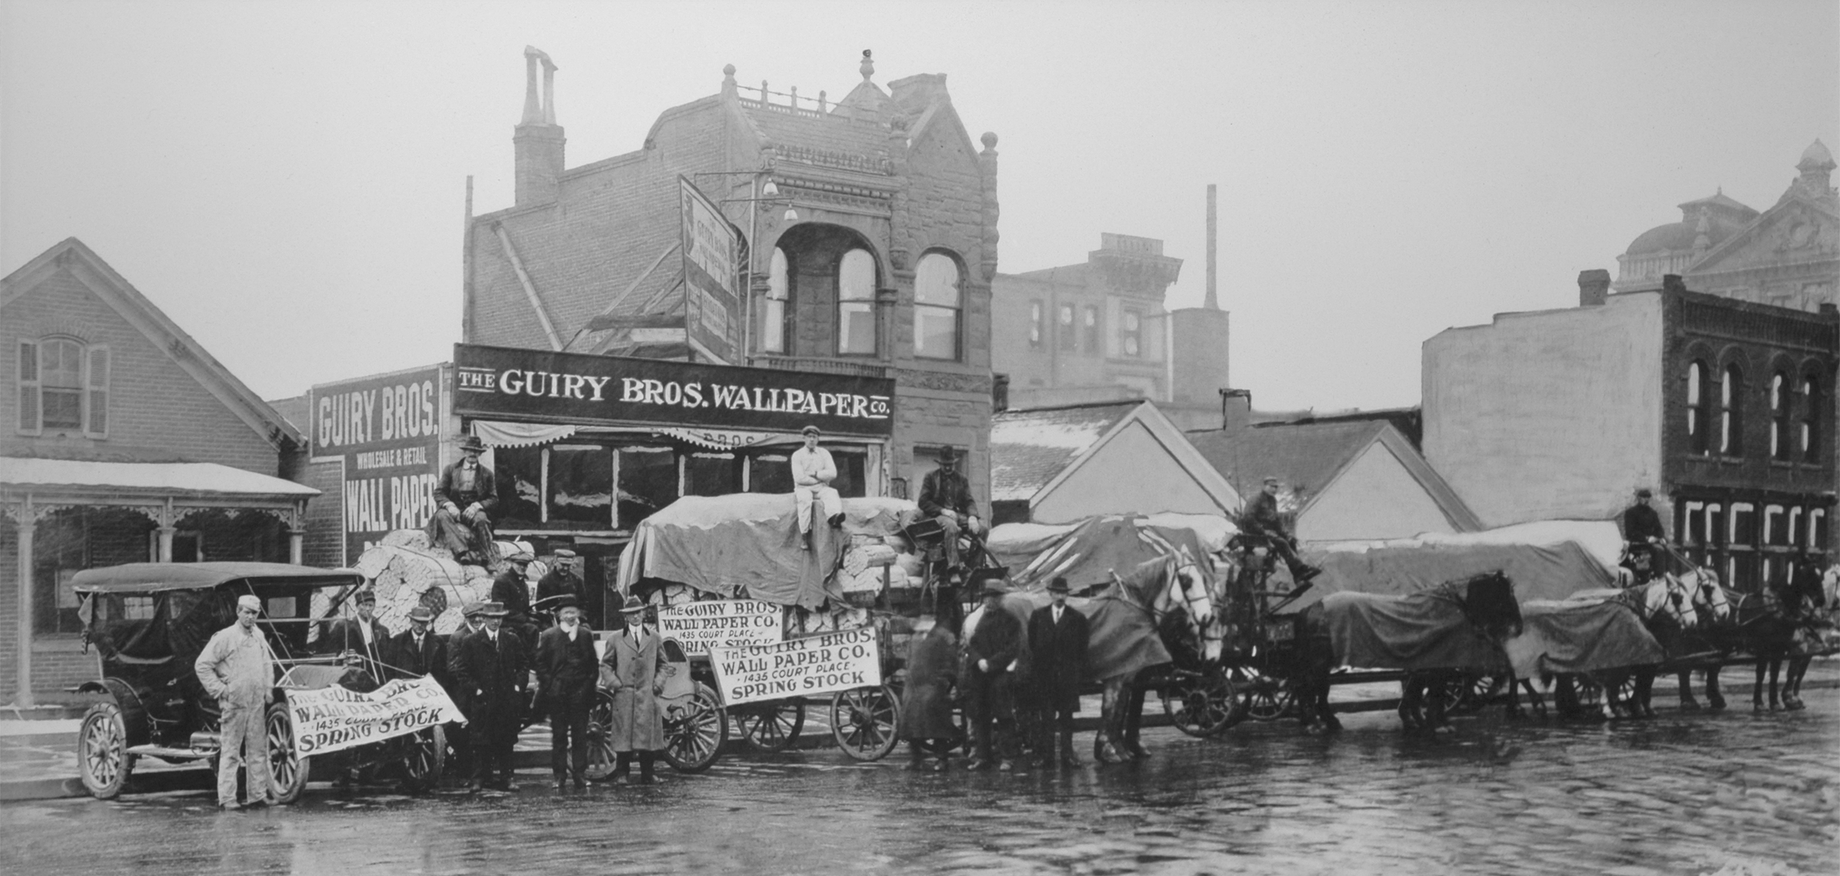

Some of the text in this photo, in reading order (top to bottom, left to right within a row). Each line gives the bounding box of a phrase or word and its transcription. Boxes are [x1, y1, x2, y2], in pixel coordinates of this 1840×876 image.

[458, 368, 890, 419] THE GUIRY BROS. WALLPAPER CO.
[318, 379, 439, 448] GUIRY BROS.
[356, 447, 428, 470] WHOLESALE & RETAIL
[347, 473, 439, 533] WALL PAPER
[662, 615, 779, 631] WALL PAPER CO.
[665, 601, 782, 617] THE GUIRY BROS.
[679, 629, 755, 640] 1435 COURT PLACE
[723, 628, 876, 661] THE GUIRY BROS.
[722, 644, 871, 676] WALL PAPER CO.
[744, 661, 851, 683] 1435 COURT PLACE
[731, 670, 865, 700] SPRING STOCK
[295, 703, 345, 723] WALL
[415, 688, 443, 699] CO.
[299, 707, 443, 753] SPRING STOCK
[316, 718, 340, 731] 1435
